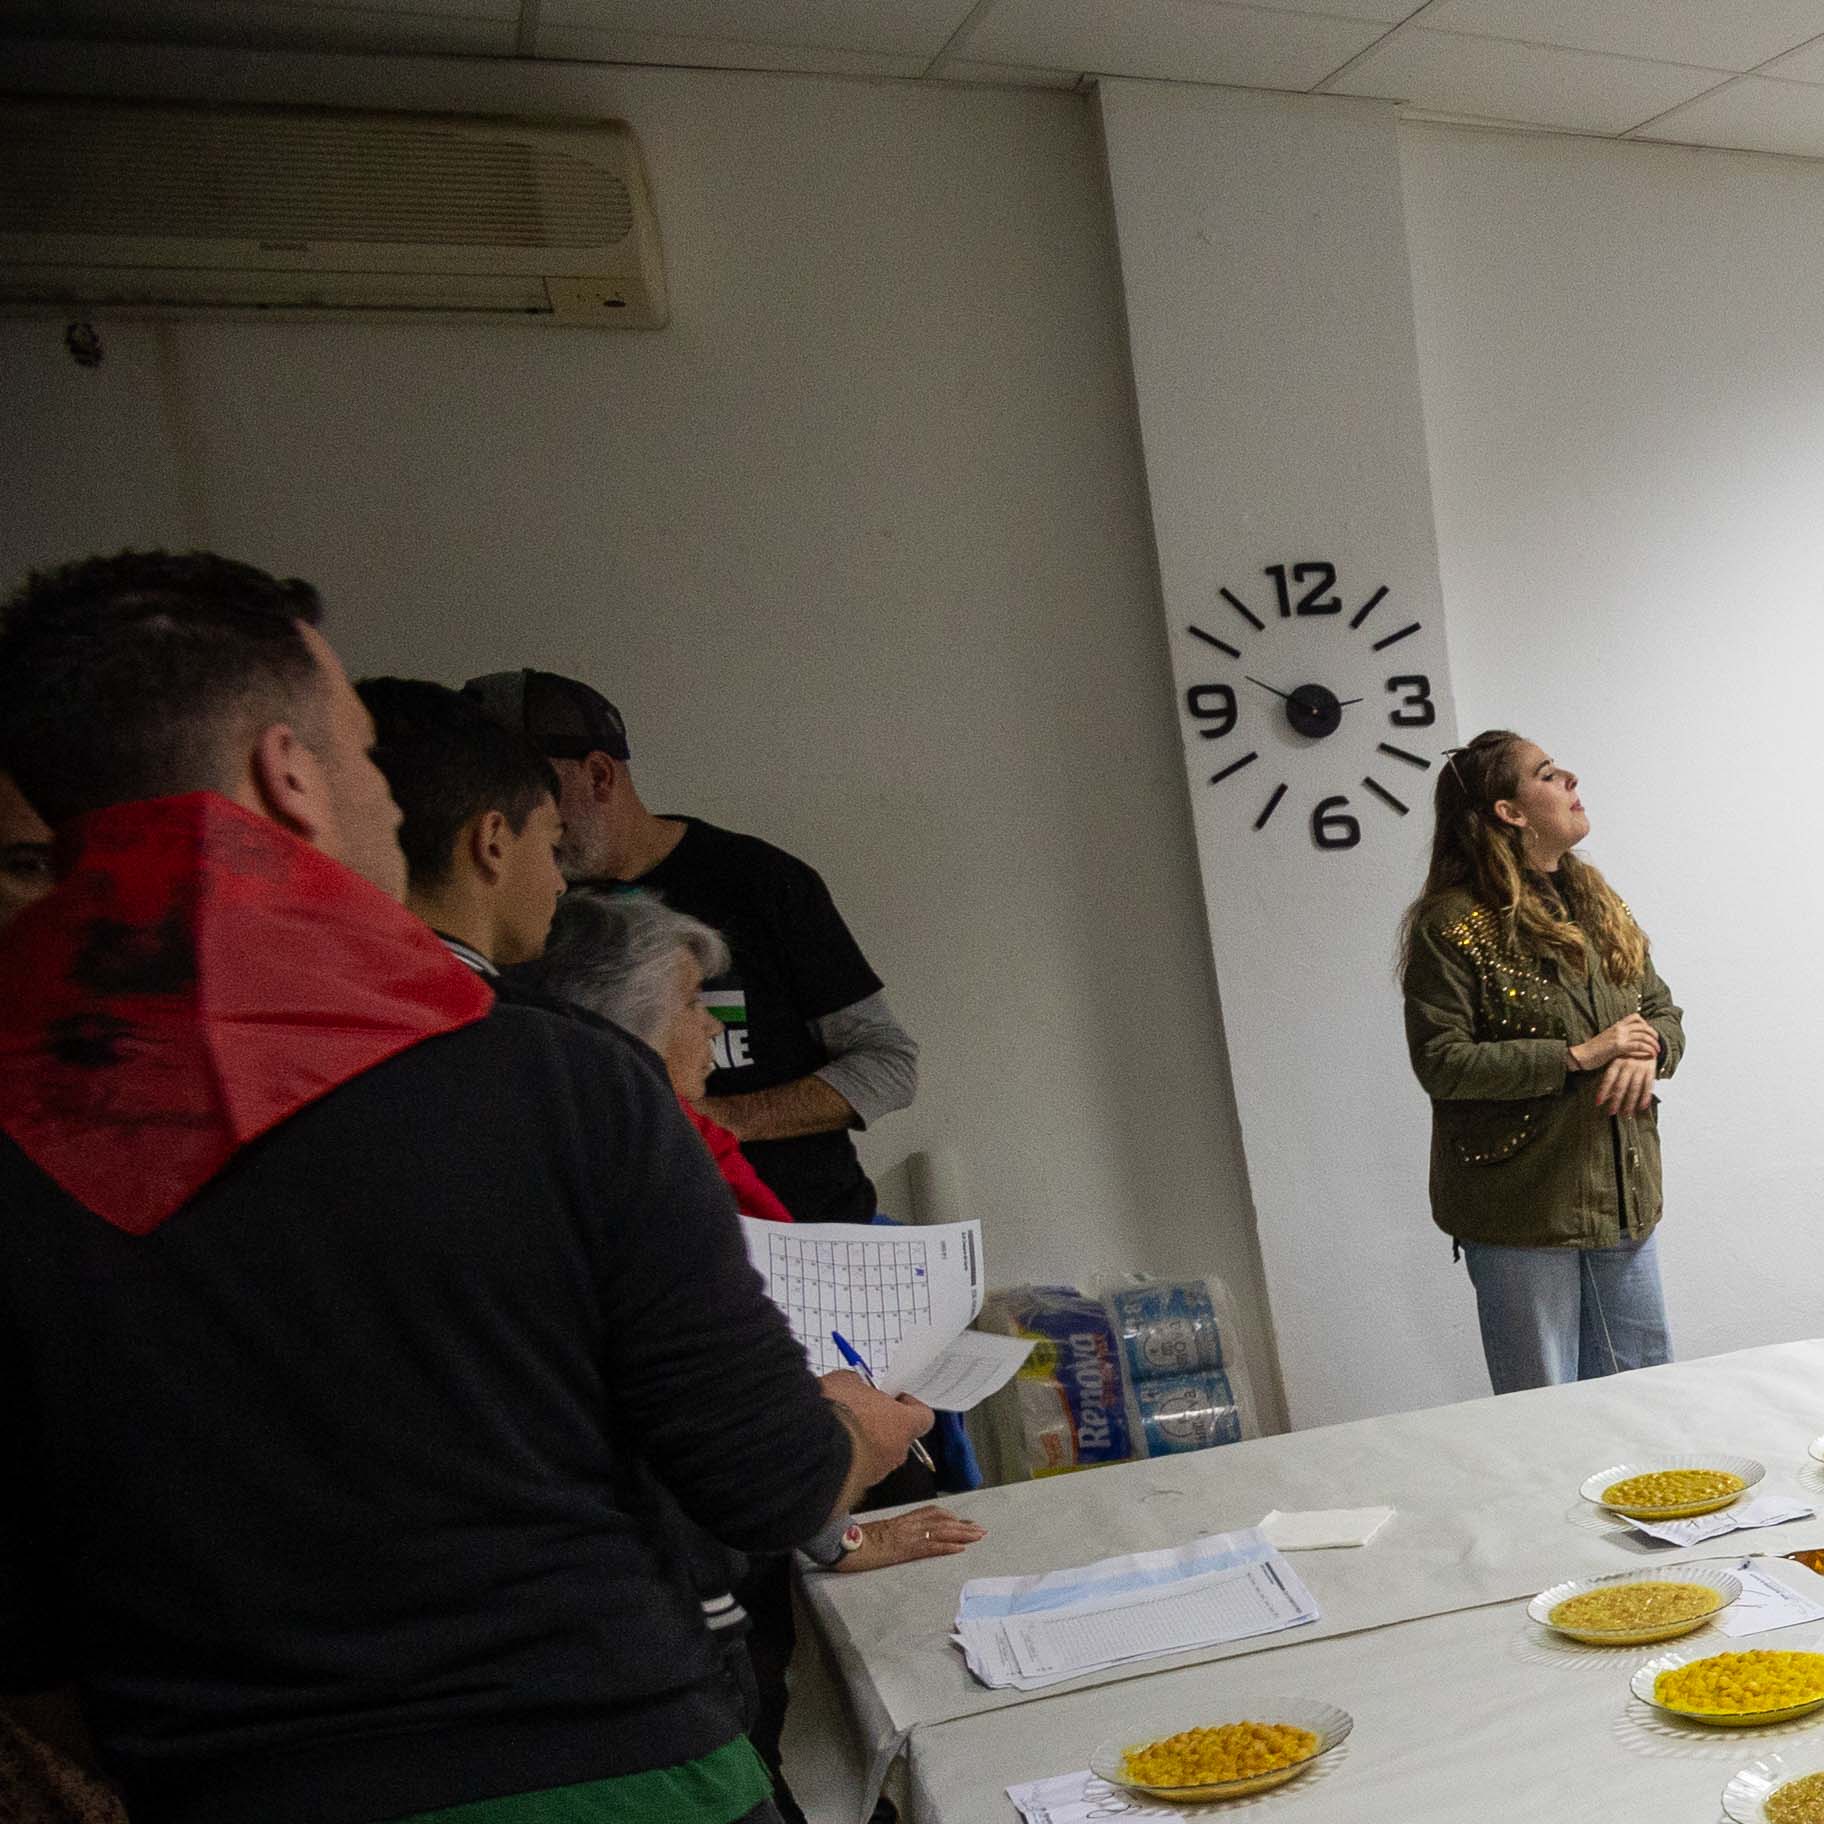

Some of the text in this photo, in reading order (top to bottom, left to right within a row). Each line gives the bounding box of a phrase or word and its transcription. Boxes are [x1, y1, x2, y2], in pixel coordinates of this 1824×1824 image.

[1265, 562, 1342, 617] 12
[1187, 684, 1237, 738] 9
[1386, 675, 1435, 727] 3
[1312, 795, 1361, 849] 6
[1069, 1332, 1112, 1449] Renova
